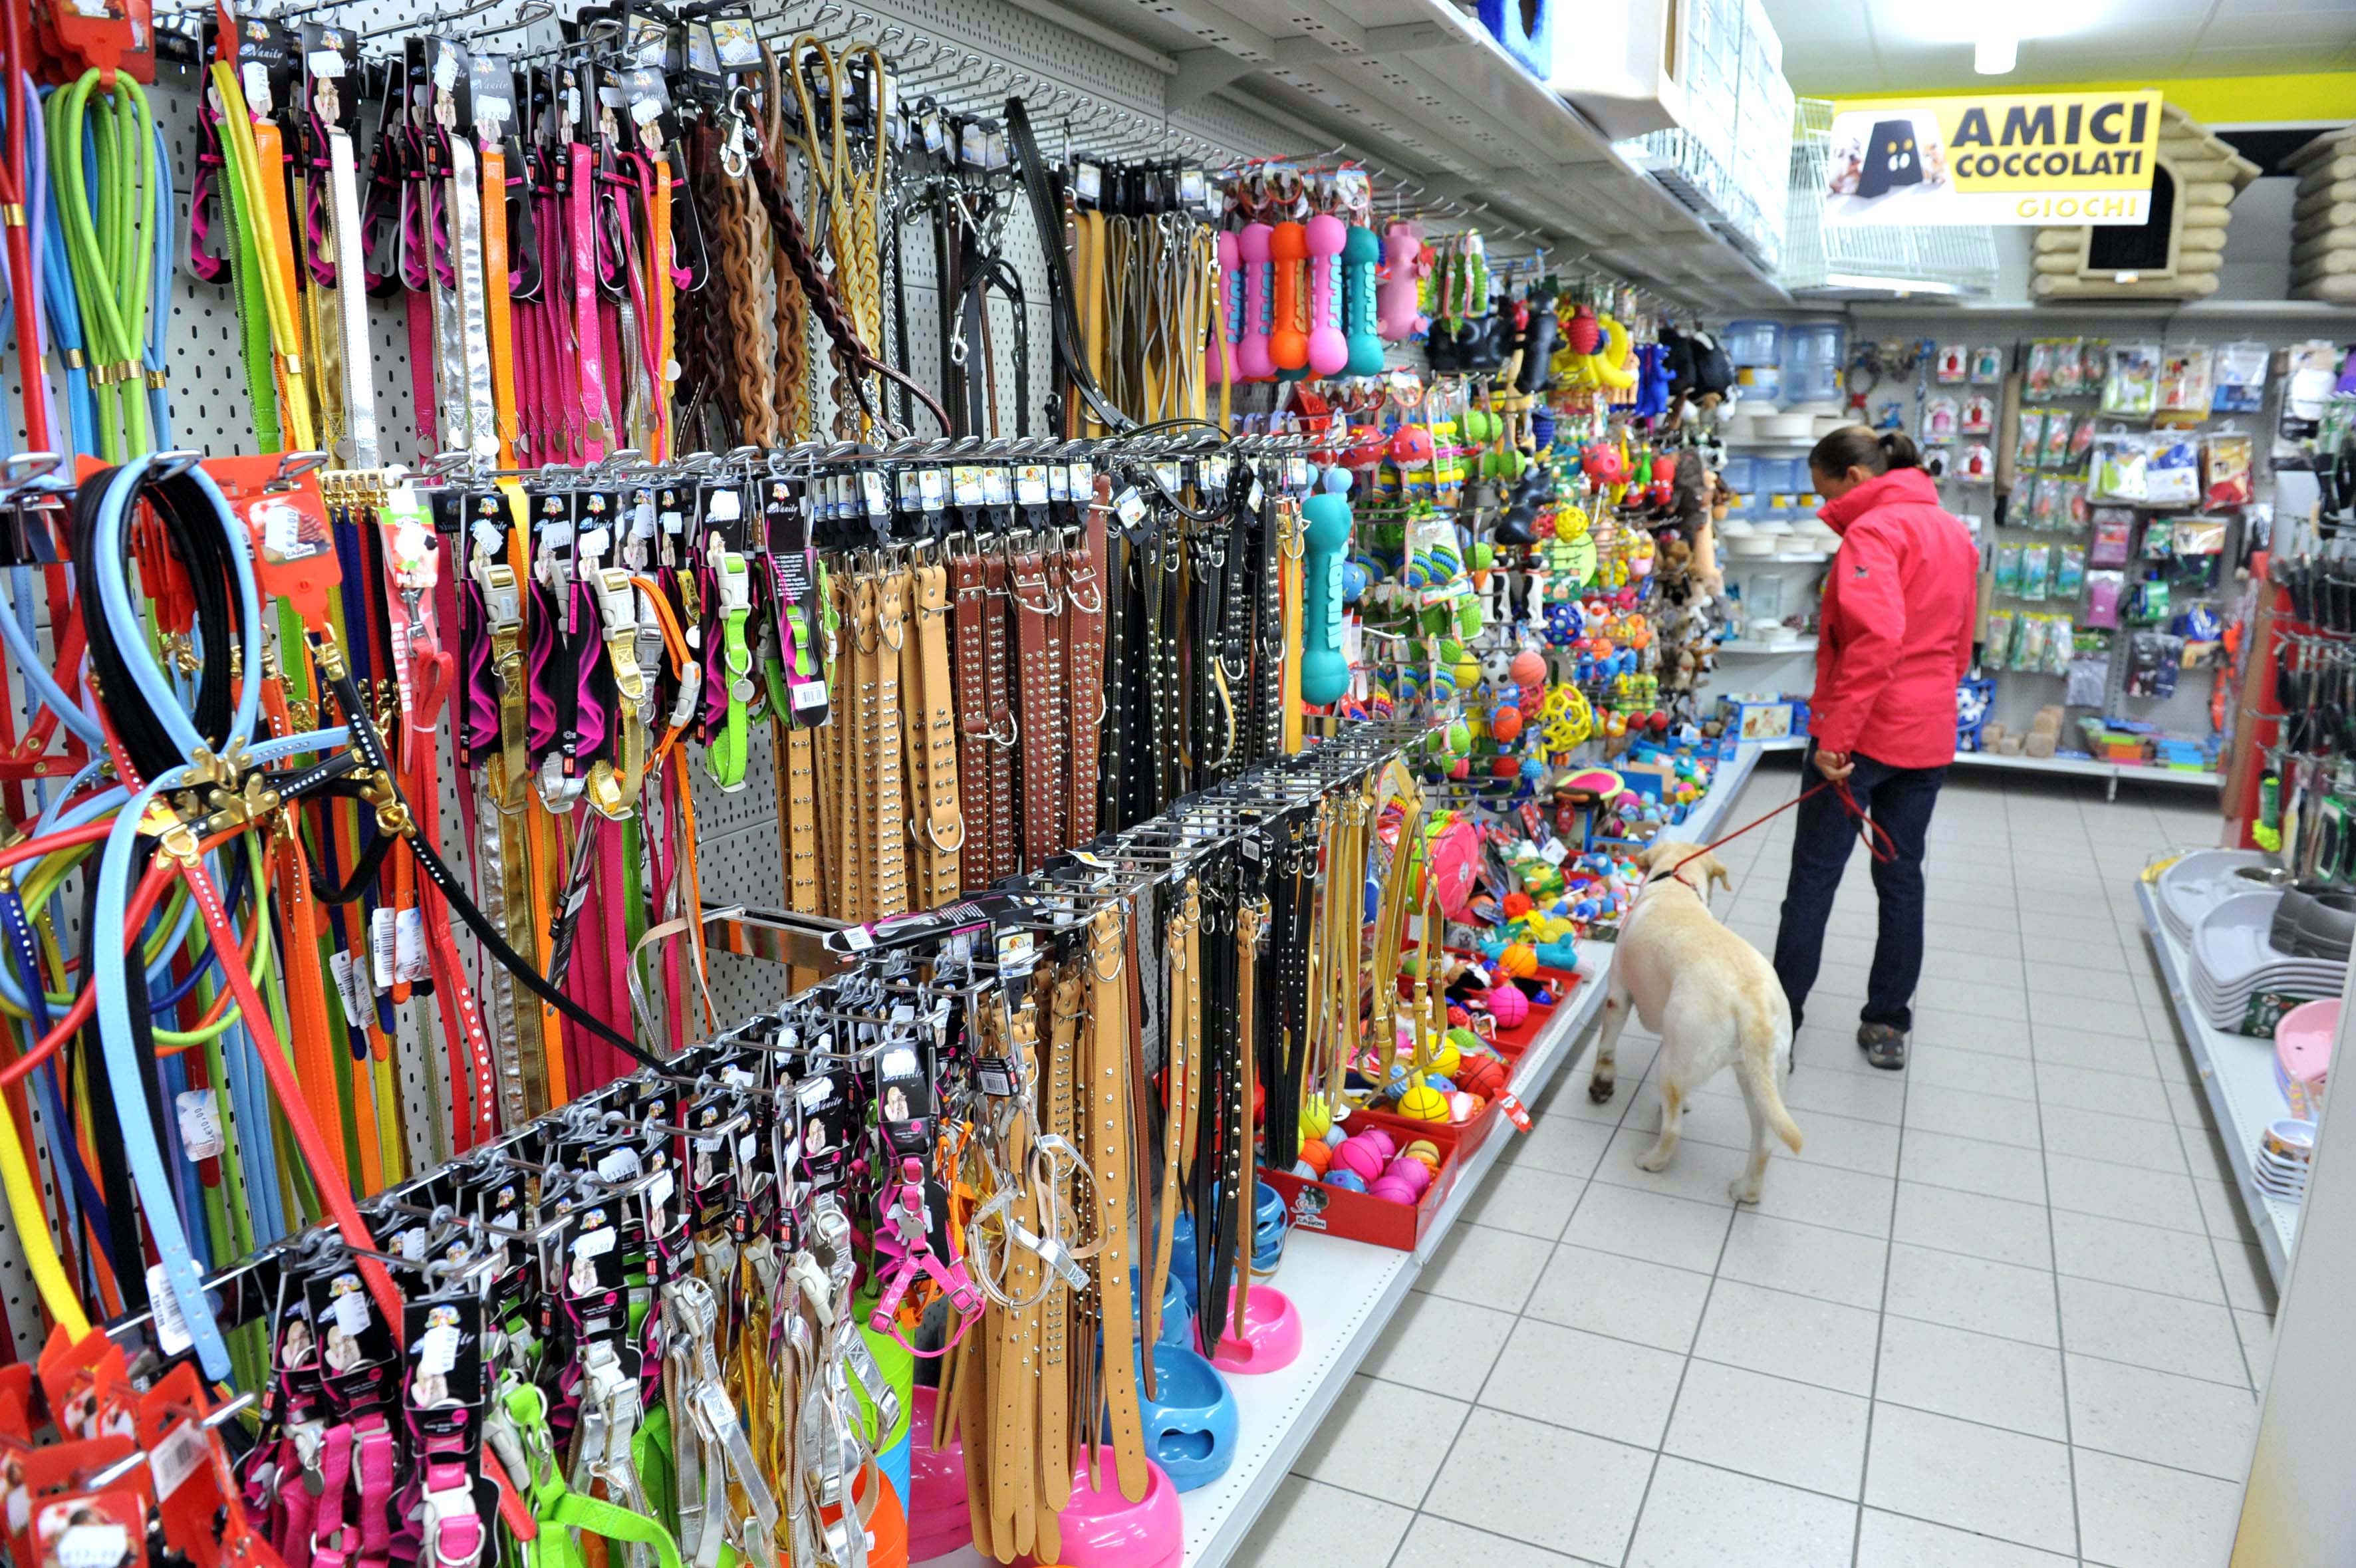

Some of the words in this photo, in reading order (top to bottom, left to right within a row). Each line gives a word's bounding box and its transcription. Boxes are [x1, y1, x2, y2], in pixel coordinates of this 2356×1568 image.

[251, 44, 283, 67] Vanity
[1950, 101, 2149, 148] AMICI
[1955, 150, 2142, 178] COCCOLATI
[2016, 197, 2139, 218] GIOCHI
[776, 503, 798, 521] Vanity
[287, 512, 297, 536] 9,00
[194, 1107, 212, 1135] €10,00
[589, 1243, 610, 1253] 7,50
